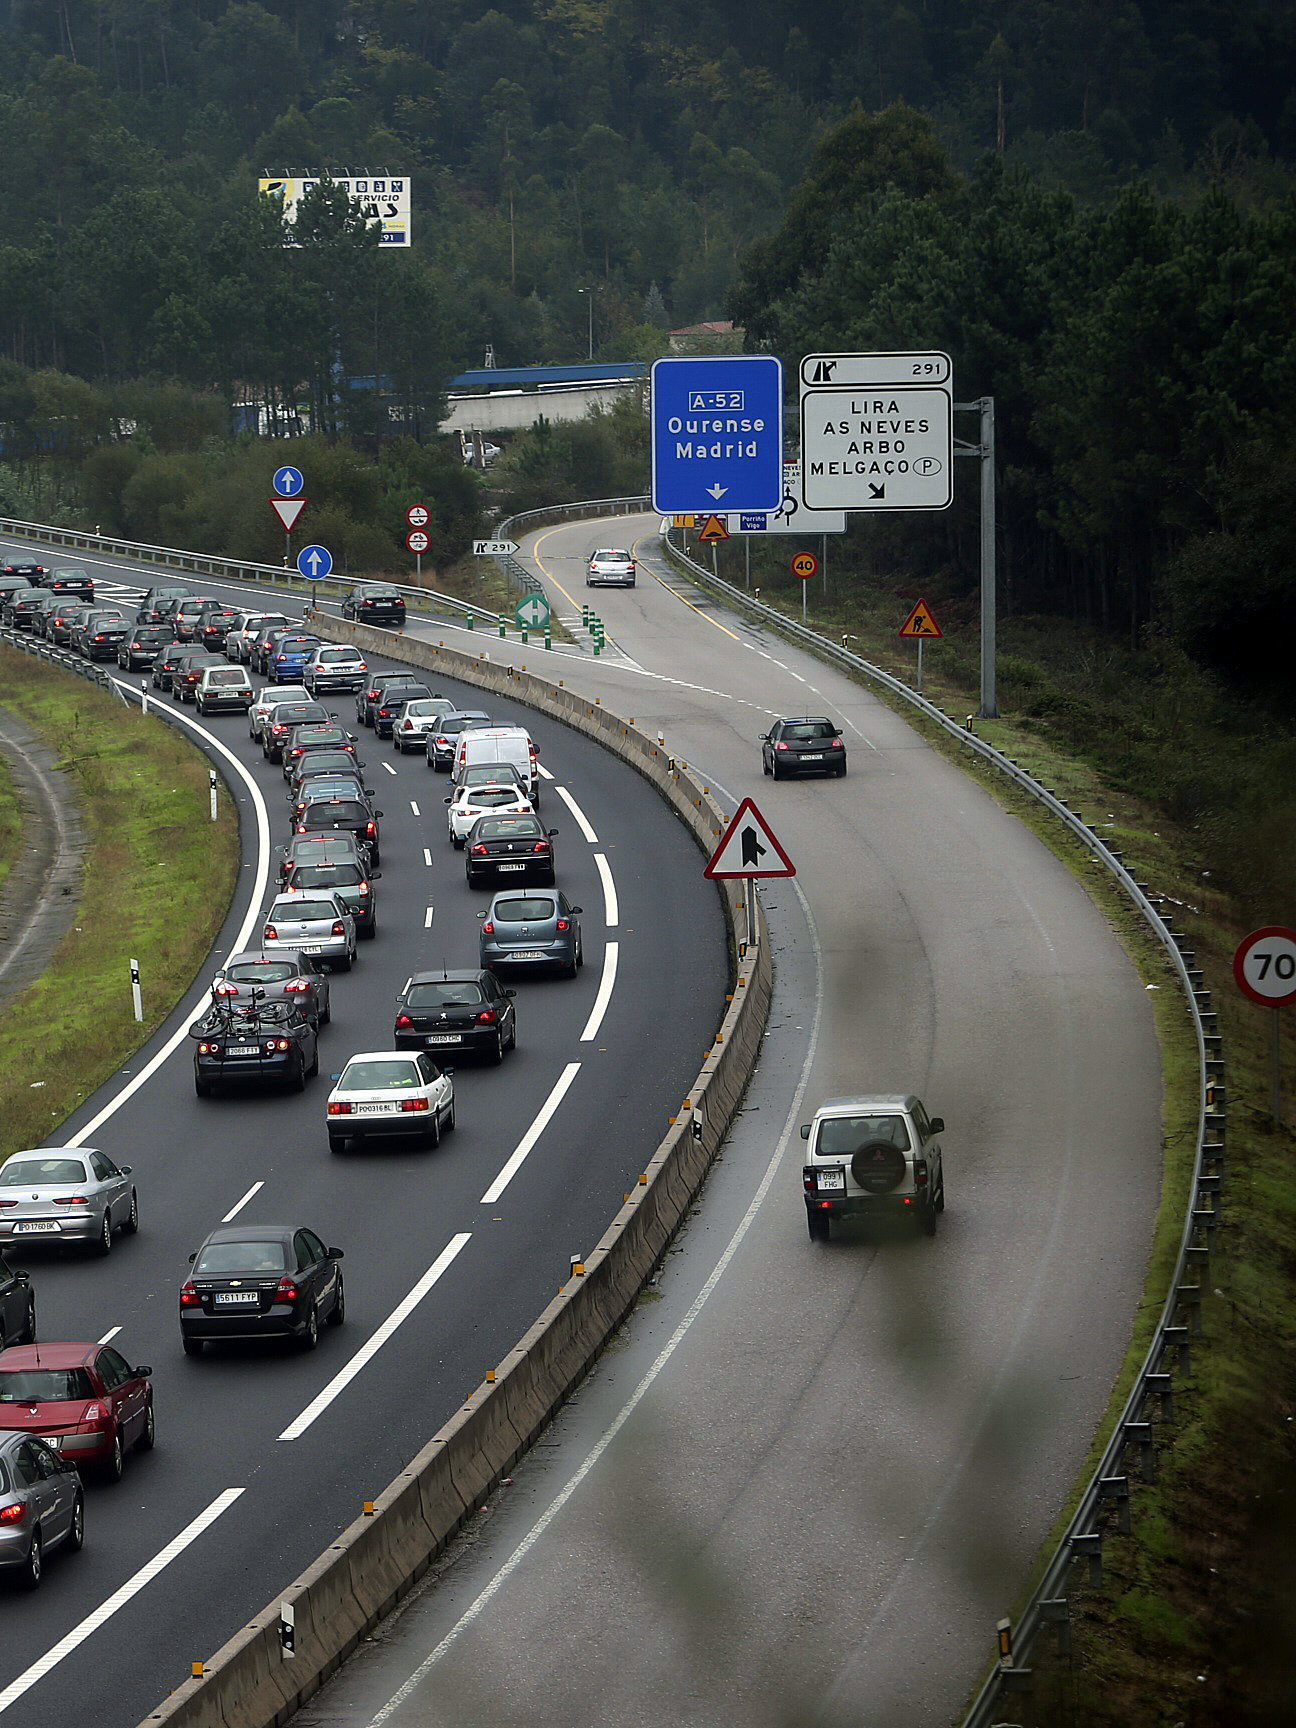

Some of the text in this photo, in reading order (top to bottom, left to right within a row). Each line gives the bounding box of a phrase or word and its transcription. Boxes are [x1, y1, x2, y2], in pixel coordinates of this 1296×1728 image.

[350, 194, 400, 202] SERVICIO
[912, 363, 940, 375] 291
[692, 393, 741, 408] A-52
[851, 400, 900, 414] LIRA
[668, 416, 765, 434] Ourense
[823, 419, 930, 435] AS NEVES
[676, 440, 757, 459] Madrid
[847, 440, 905, 455] ARBO
[810, 460, 909, 476] MELGAÇO
[492, 544, 510, 552] 291
[795, 561, 813, 571] 40
[1253, 953, 1295, 981] 70
[220, 1293, 239, 1302] 5611
